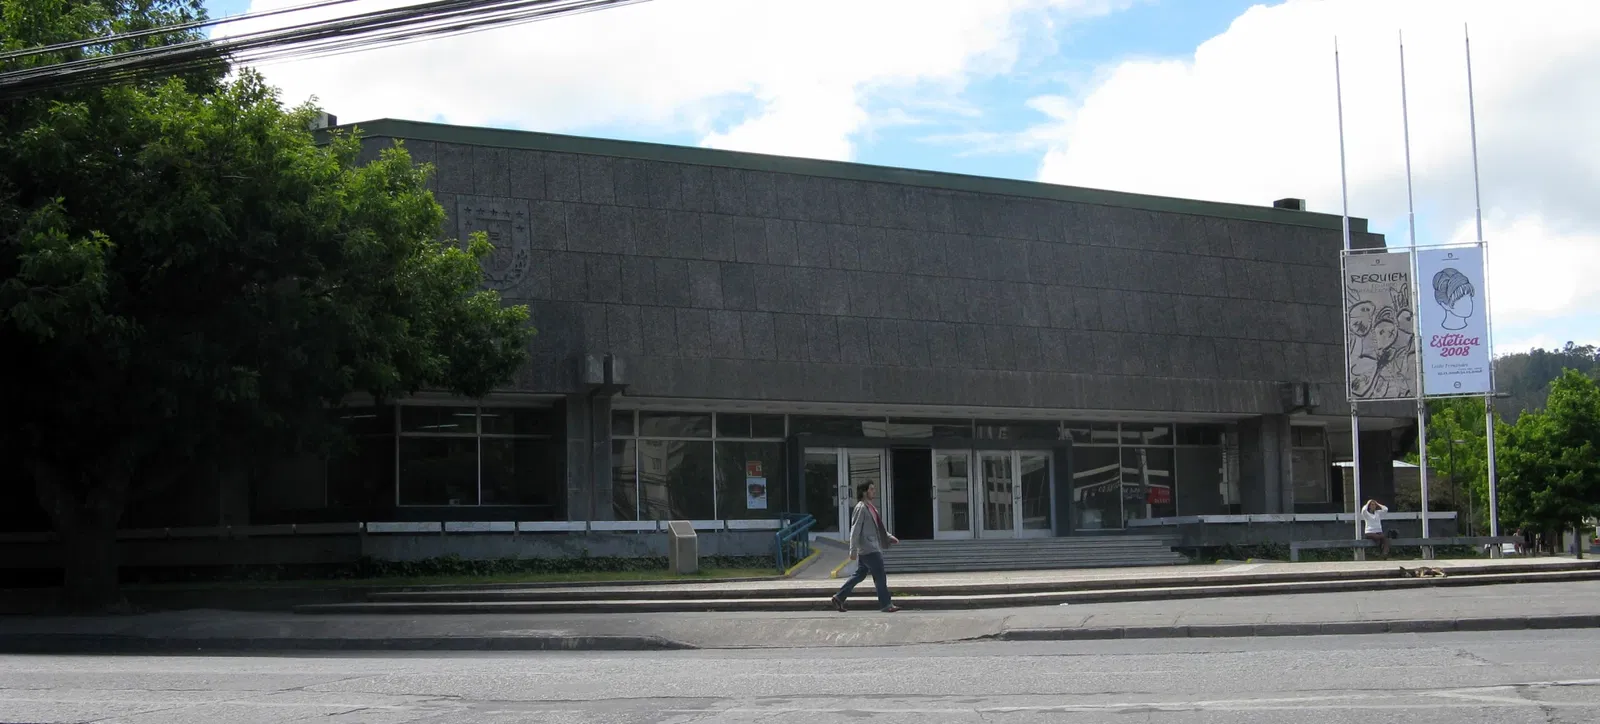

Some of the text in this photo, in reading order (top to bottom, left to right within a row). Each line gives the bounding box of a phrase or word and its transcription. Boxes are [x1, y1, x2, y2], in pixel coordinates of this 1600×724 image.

[1350, 272, 1408, 284] REQUIEM
[1430, 333, 1480, 348] Estética
[1440, 346, 1470, 357] 2008
